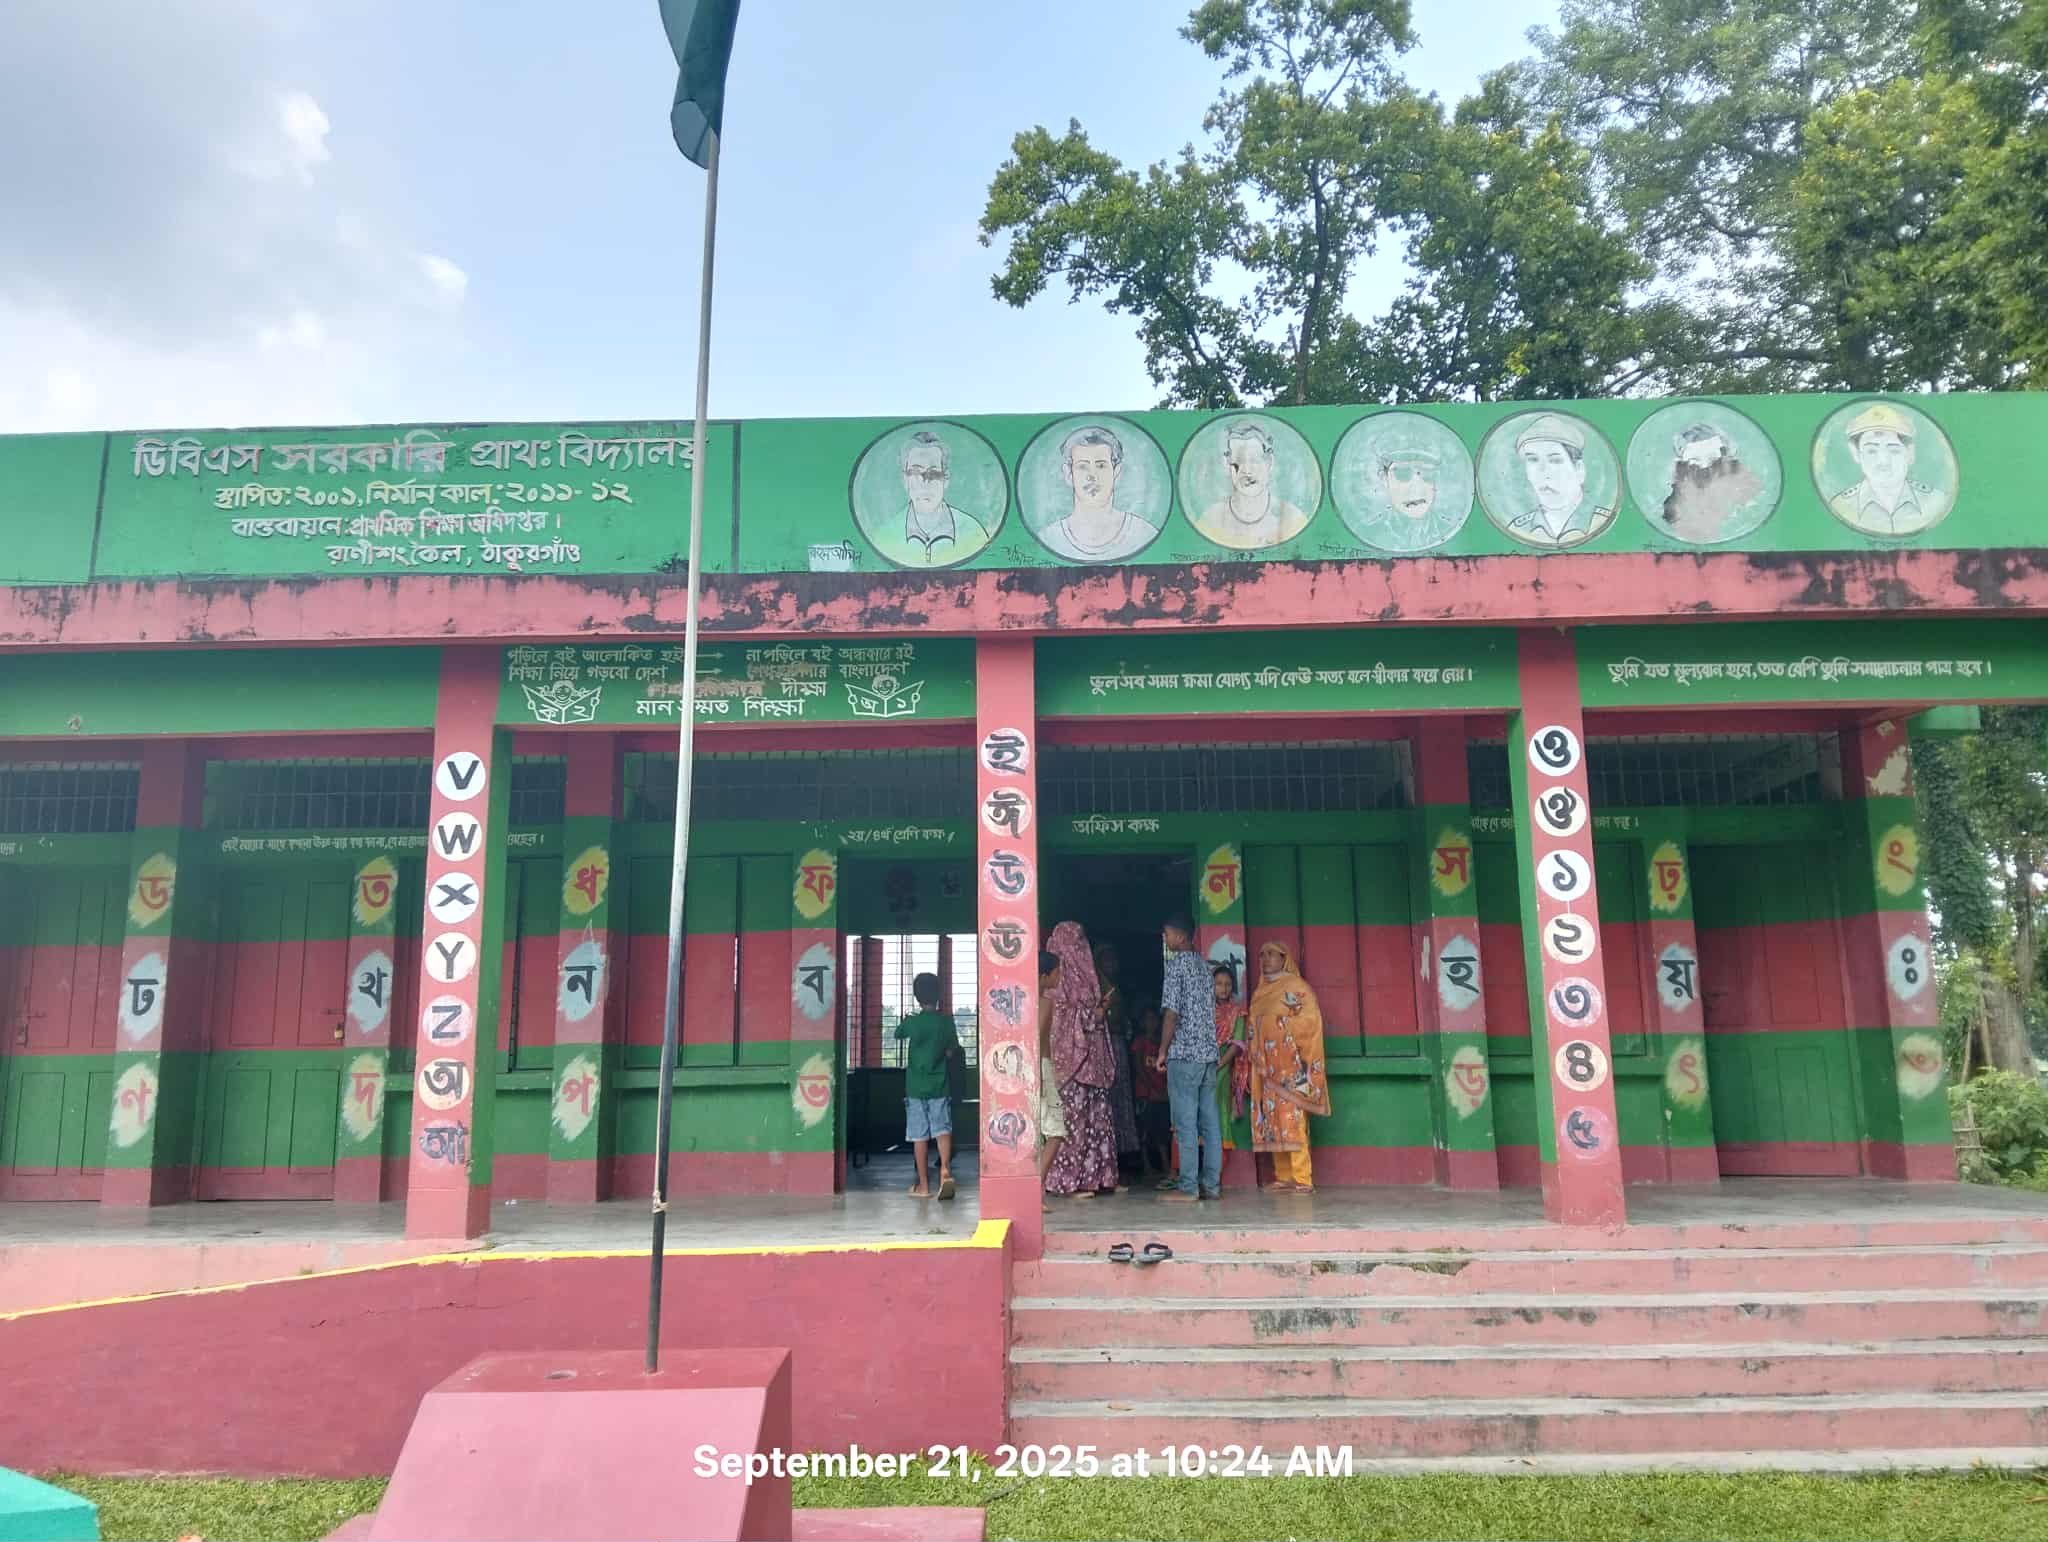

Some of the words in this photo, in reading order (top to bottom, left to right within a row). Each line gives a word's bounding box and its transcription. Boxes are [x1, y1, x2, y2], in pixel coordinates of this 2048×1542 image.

[132, 438, 265, 477] ডিবিএস
[271, 429, 457, 474] সরকারি
[470, 439, 552, 471] প্রাথঃ
[419, 507, 466, 539] শিক্ষা
[467, 506, 548, 534] অধিদপ্তর
[480, 536, 582, 571] ঠাকুরগাঁও
[508, 661, 545, 682] শিক্ষা
[635, 666, 668, 680] দেশ
[554, 647, 577, 664] বই
[582, 645, 654, 663] আলোকিত
[811, 646, 833, 662] বই
[839, 662, 911, 678] বাংলাদেশ
[1608, 656, 1645, 686] তুমি
[1645, 663, 1671, 678] যত
[1821, 656, 1850, 683] তুমি
[780, 678, 828, 697] দীক্ষা
[1148, 674, 1179, 689] সময়
[1182, 673, 1213, 689] ক্ষমা
[1253, 666, 1281, 688] যদি
[1281, 666, 1312, 686] কেউ
[1315, 670, 1346, 685] সত্য
[538, 703, 559, 719] ক
[573, 705, 590, 718] ২
[636, 699, 675, 716] মান
[860, 697, 879, 713] অ
[985, 733, 1026, 774] ই
[1534, 730, 1572, 768] ও
[446, 760, 479, 790] V
[988, 790, 1025, 839] ঈ
[1072, 814, 1126, 835] অফিস
[1128, 818, 1160, 833] কক্ষ
[1540, 786, 1577, 830] ঔ
[437, 823, 478, 855] W
[575, 864, 604, 904] ধ
[990, 849, 1025, 894] উ
[1207, 864, 1238, 900] ল
[1434, 847, 1472, 884] স
[1552, 854, 1577, 891] ১
[1654, 861, 1684, 901] ঢ়
[139, 877, 171, 909] ড
[361, 874, 393, 908] ত
[436, 882, 476, 907] X
[802, 865, 834, 904] ফ
[1553, 918, 1583, 956] ২
[435, 940, 465, 979] Y
[1440, 956, 1480, 994] হ
[128, 978, 158, 1016] ঢ
[359, 967, 388, 1008] থ
[565, 965, 598, 1004] ন
[799, 965, 832, 1004] ব
[1661, 960, 1696, 1000] য়
[1554, 984, 1591, 1018] ৩
[431, 1004, 461, 1039] Z
[1565, 1039, 1594, 1081] ৪
[1680, 1054, 1700, 1094] ৎ
[351, 1072, 380, 1121] দ
[424, 1061, 466, 1100] অ
[562, 1072, 595, 1117] প
[799, 1074, 831, 1107] ভ
[1454, 1063, 1488, 1106] ড়
[419, 1120, 468, 1164] আ
